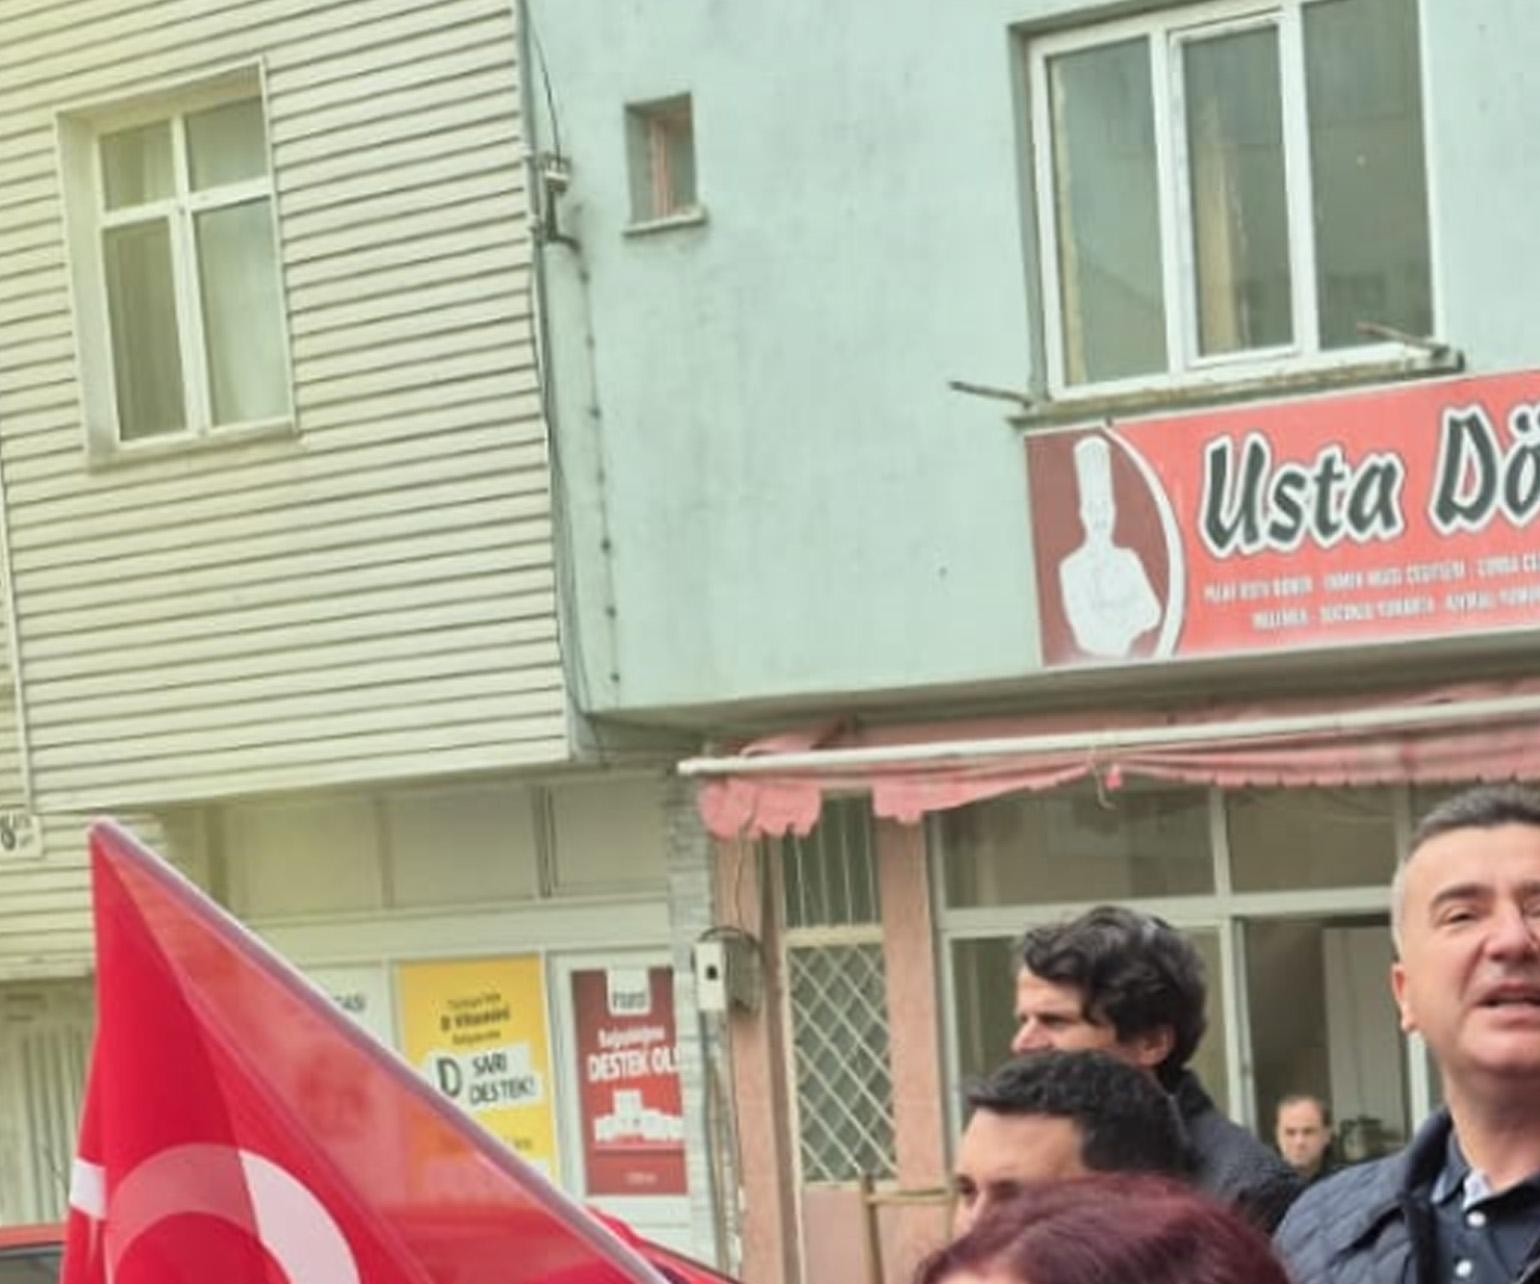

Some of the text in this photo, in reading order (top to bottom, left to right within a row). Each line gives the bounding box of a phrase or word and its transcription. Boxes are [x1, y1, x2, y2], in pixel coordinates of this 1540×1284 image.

[1206, 440, 1397, 549] Usta
[437, 1050, 507, 1098] D SARI
[587, 1048, 651, 1083] DESTEK
